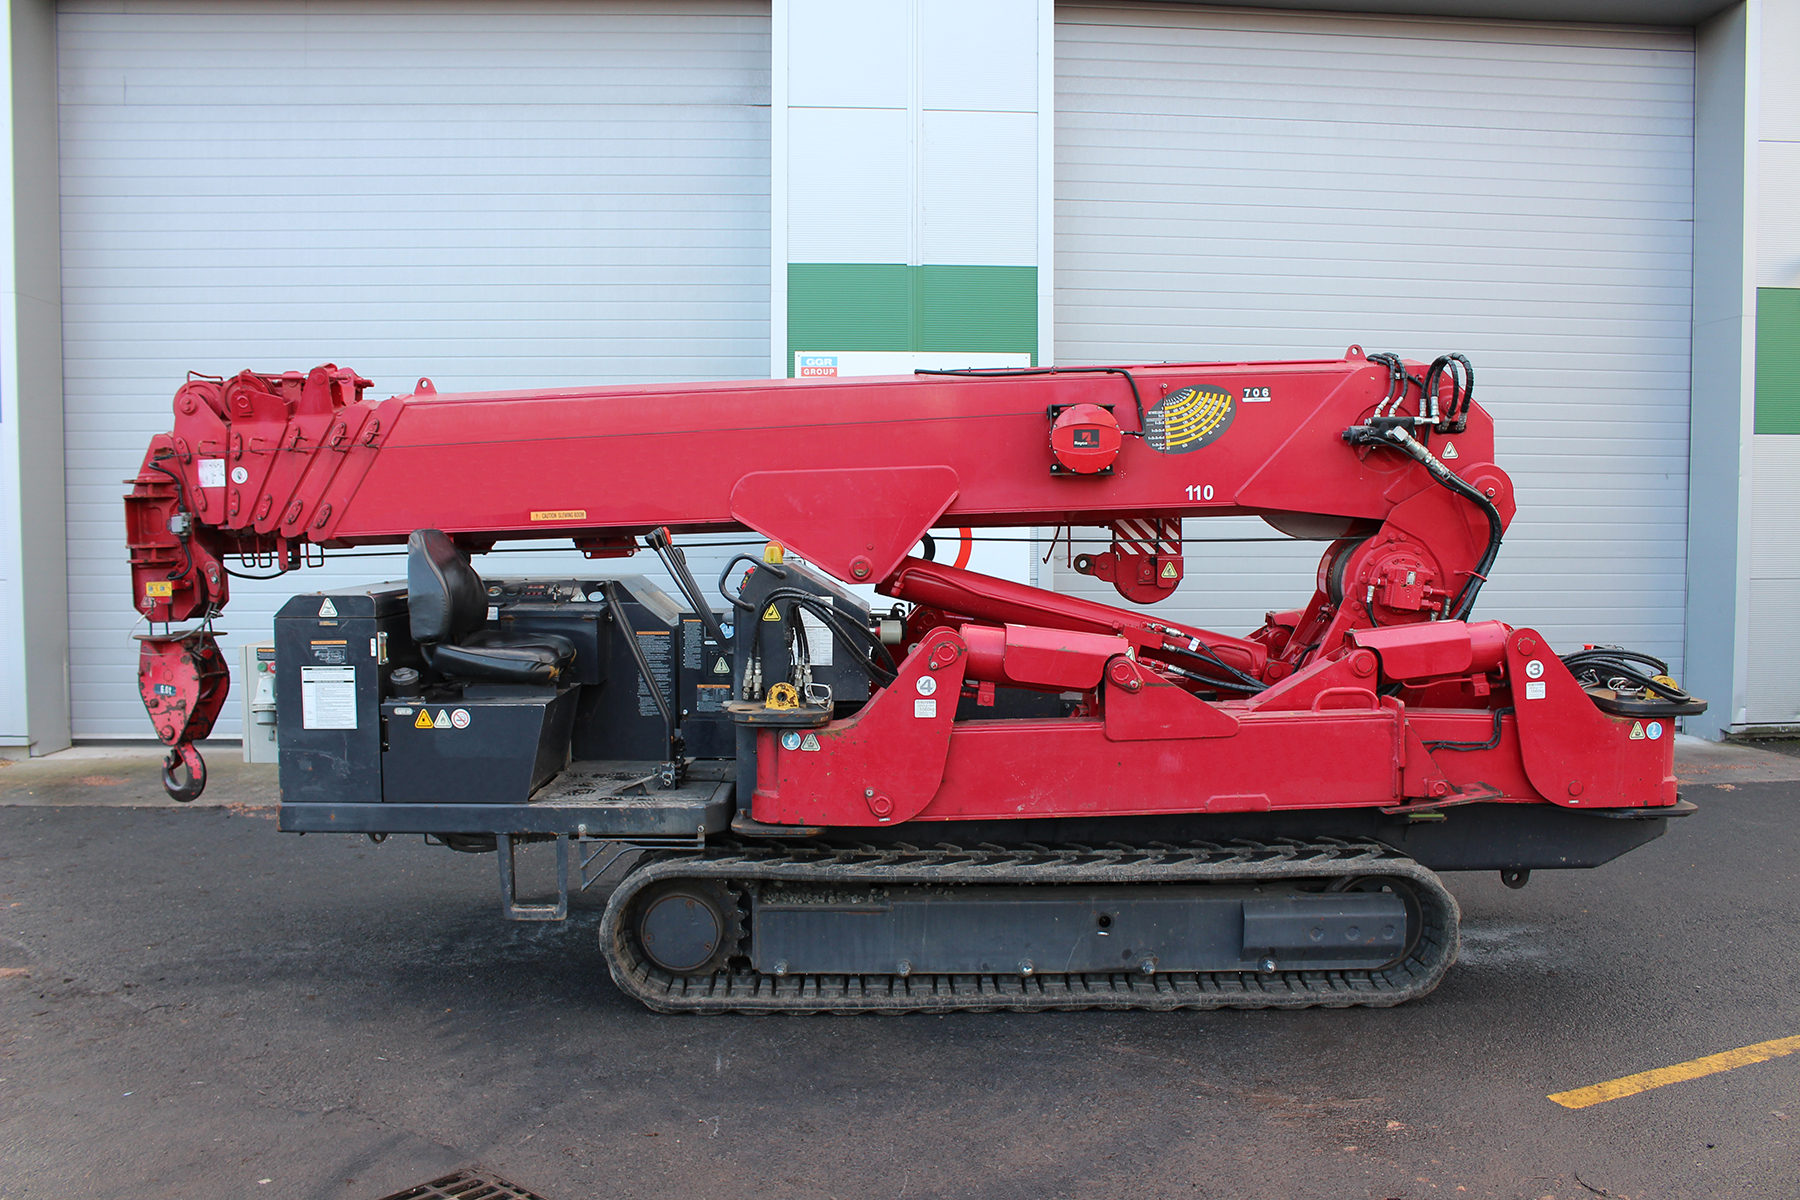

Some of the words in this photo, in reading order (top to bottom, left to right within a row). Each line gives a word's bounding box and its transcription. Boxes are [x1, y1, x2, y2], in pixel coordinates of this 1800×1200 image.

[805, 358, 833, 366] GGR
[803, 368, 835, 376] GROUP
[1243, 388, 1269, 398] 706
[1185, 484, 1214, 501] 110
[1530, 663, 1541, 676] 3
[919, 679, 933, 693] 4
